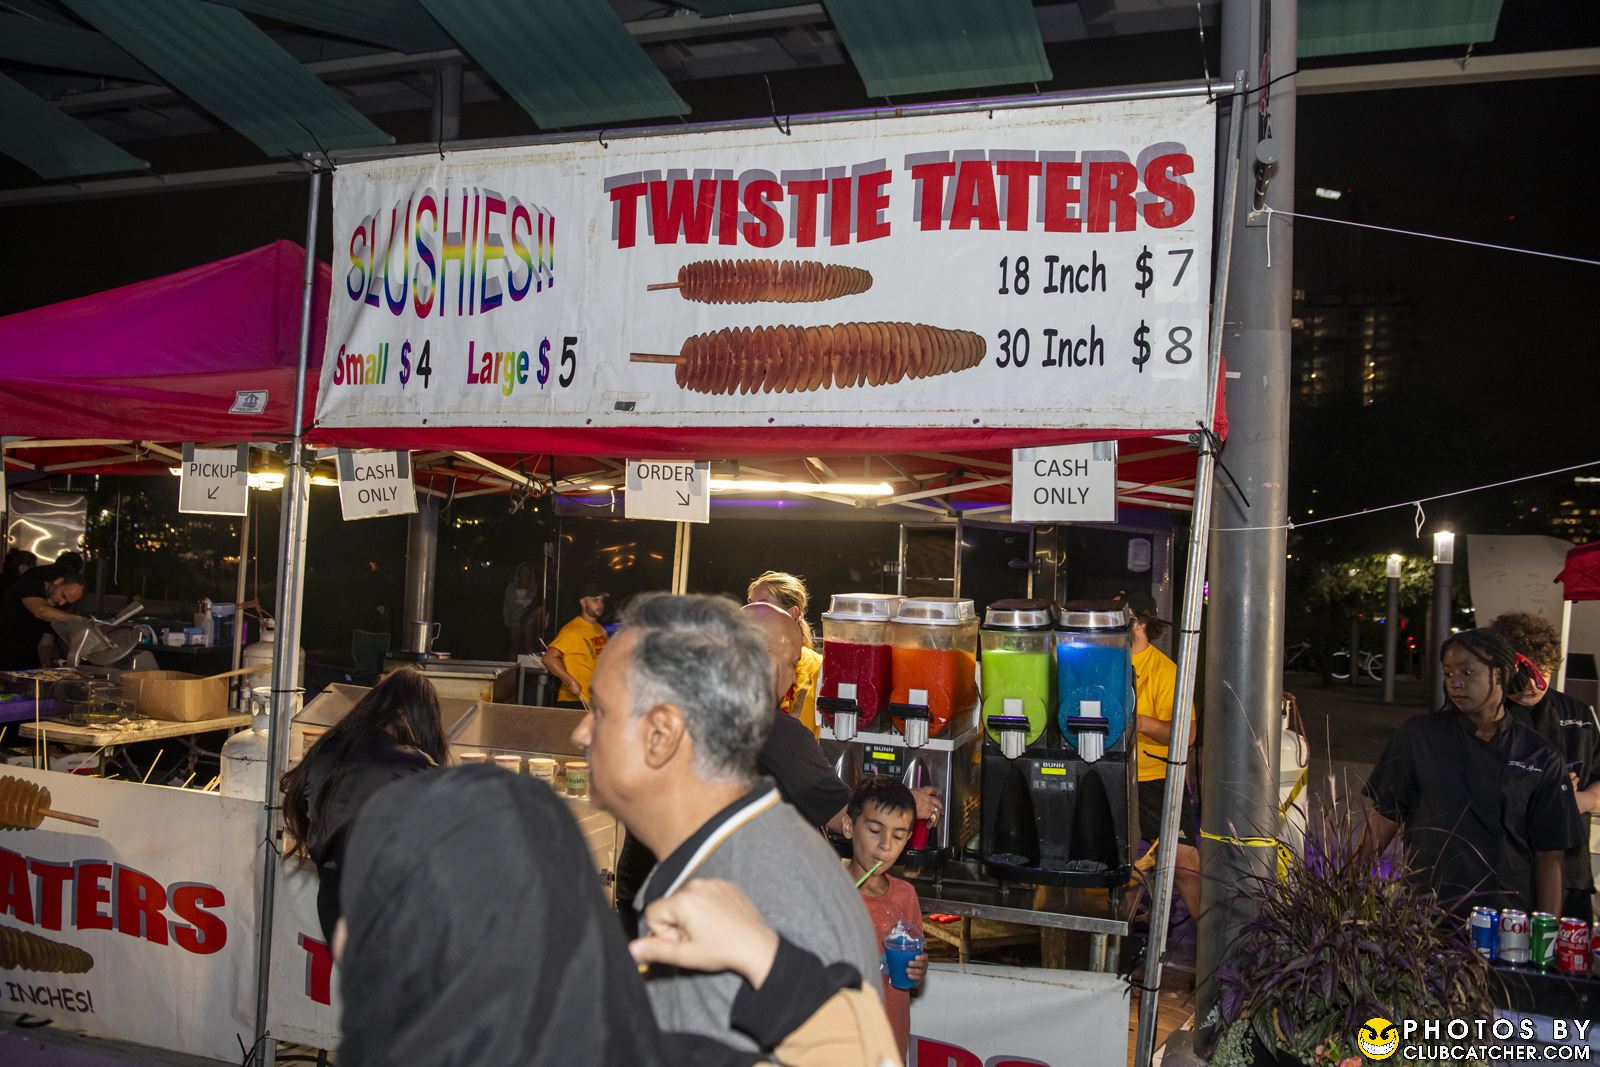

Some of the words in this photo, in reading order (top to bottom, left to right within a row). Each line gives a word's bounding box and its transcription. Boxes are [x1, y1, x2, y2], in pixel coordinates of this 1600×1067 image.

[603, 167, 893, 249] TWISTIE
[904, 141, 1196, 233] TATERS
[346, 187, 556, 319] SLUSHIES!!
[998, 255, 1030, 296] 18
[1043, 250, 1107, 294] Inch
[995, 327, 1030, 369] 30
[1041, 324, 1105, 367] Inch
[333, 341, 390, 385] Small
[466, 339, 529, 397] Large
[189, 462, 238, 479] PICKUP
[354, 463, 395, 482] CASH
[637, 463, 695, 482] ORDER
[1033, 458, 1089, 477] CASH
[357, 486, 398, 504] ONLY
[1033, 487, 1090, 505] ONLY
[873, 745, 895, 753] BUNN
[5, 980, 95, 1014] INCHES!
